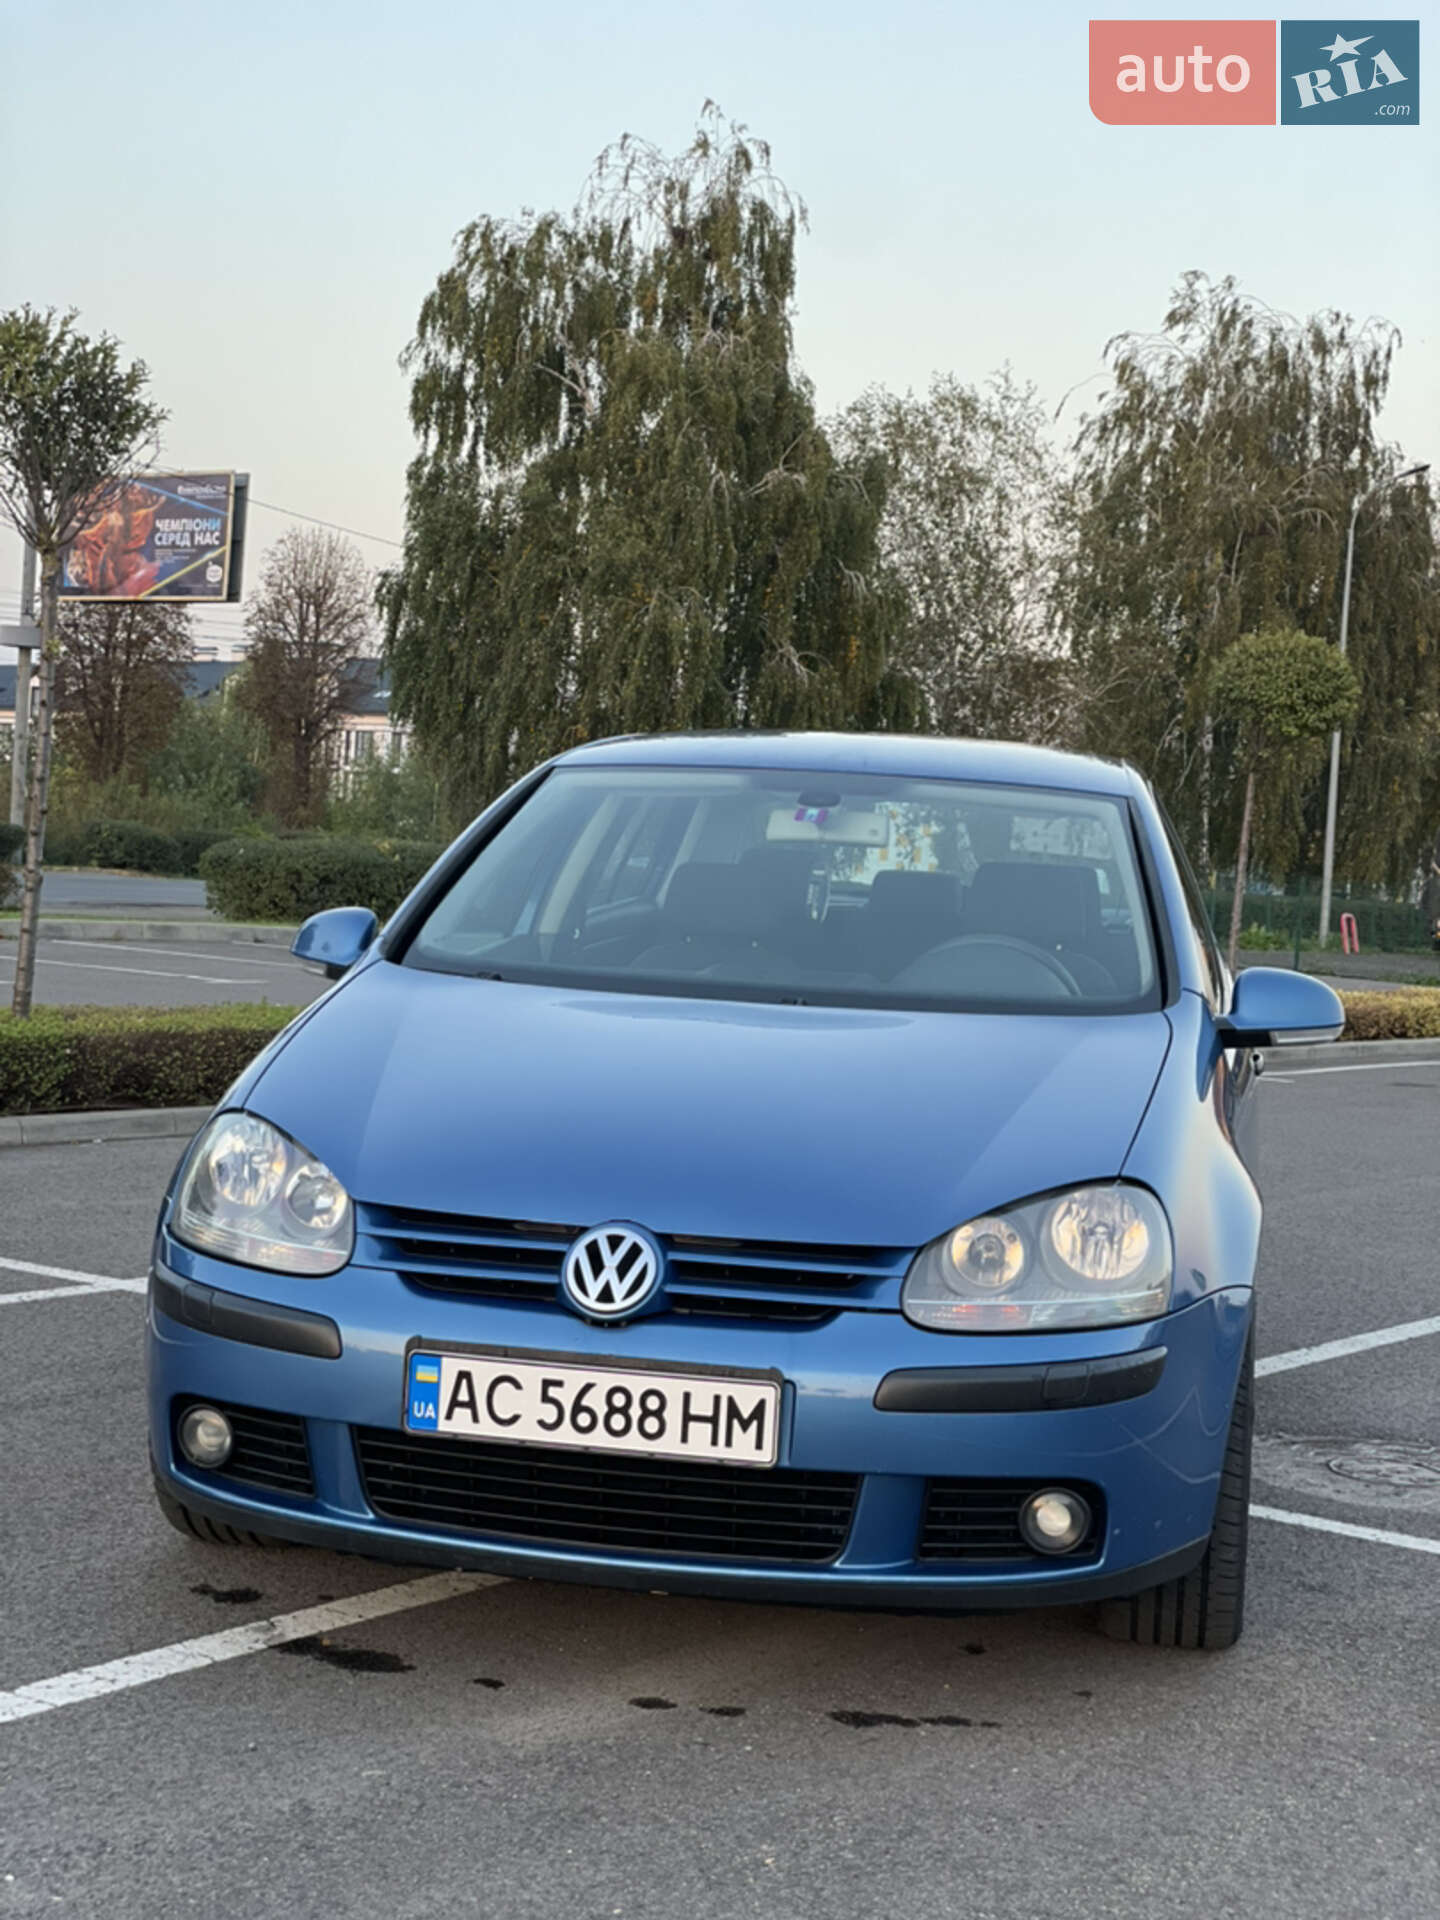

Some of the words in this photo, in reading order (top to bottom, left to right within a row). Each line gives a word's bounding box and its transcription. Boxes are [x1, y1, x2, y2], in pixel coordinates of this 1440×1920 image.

[155, 518, 222, 532] ЧЕМПІОНИ
[154, 532, 191, 547] СЕРЕД
[194, 531, 220, 545] НАС
[413, 1400, 436, 1419] UA
[444, 1370, 523, 1427] AC
[536, 1378, 668, 1441] 5688
[680, 1391, 766, 1451] HM
